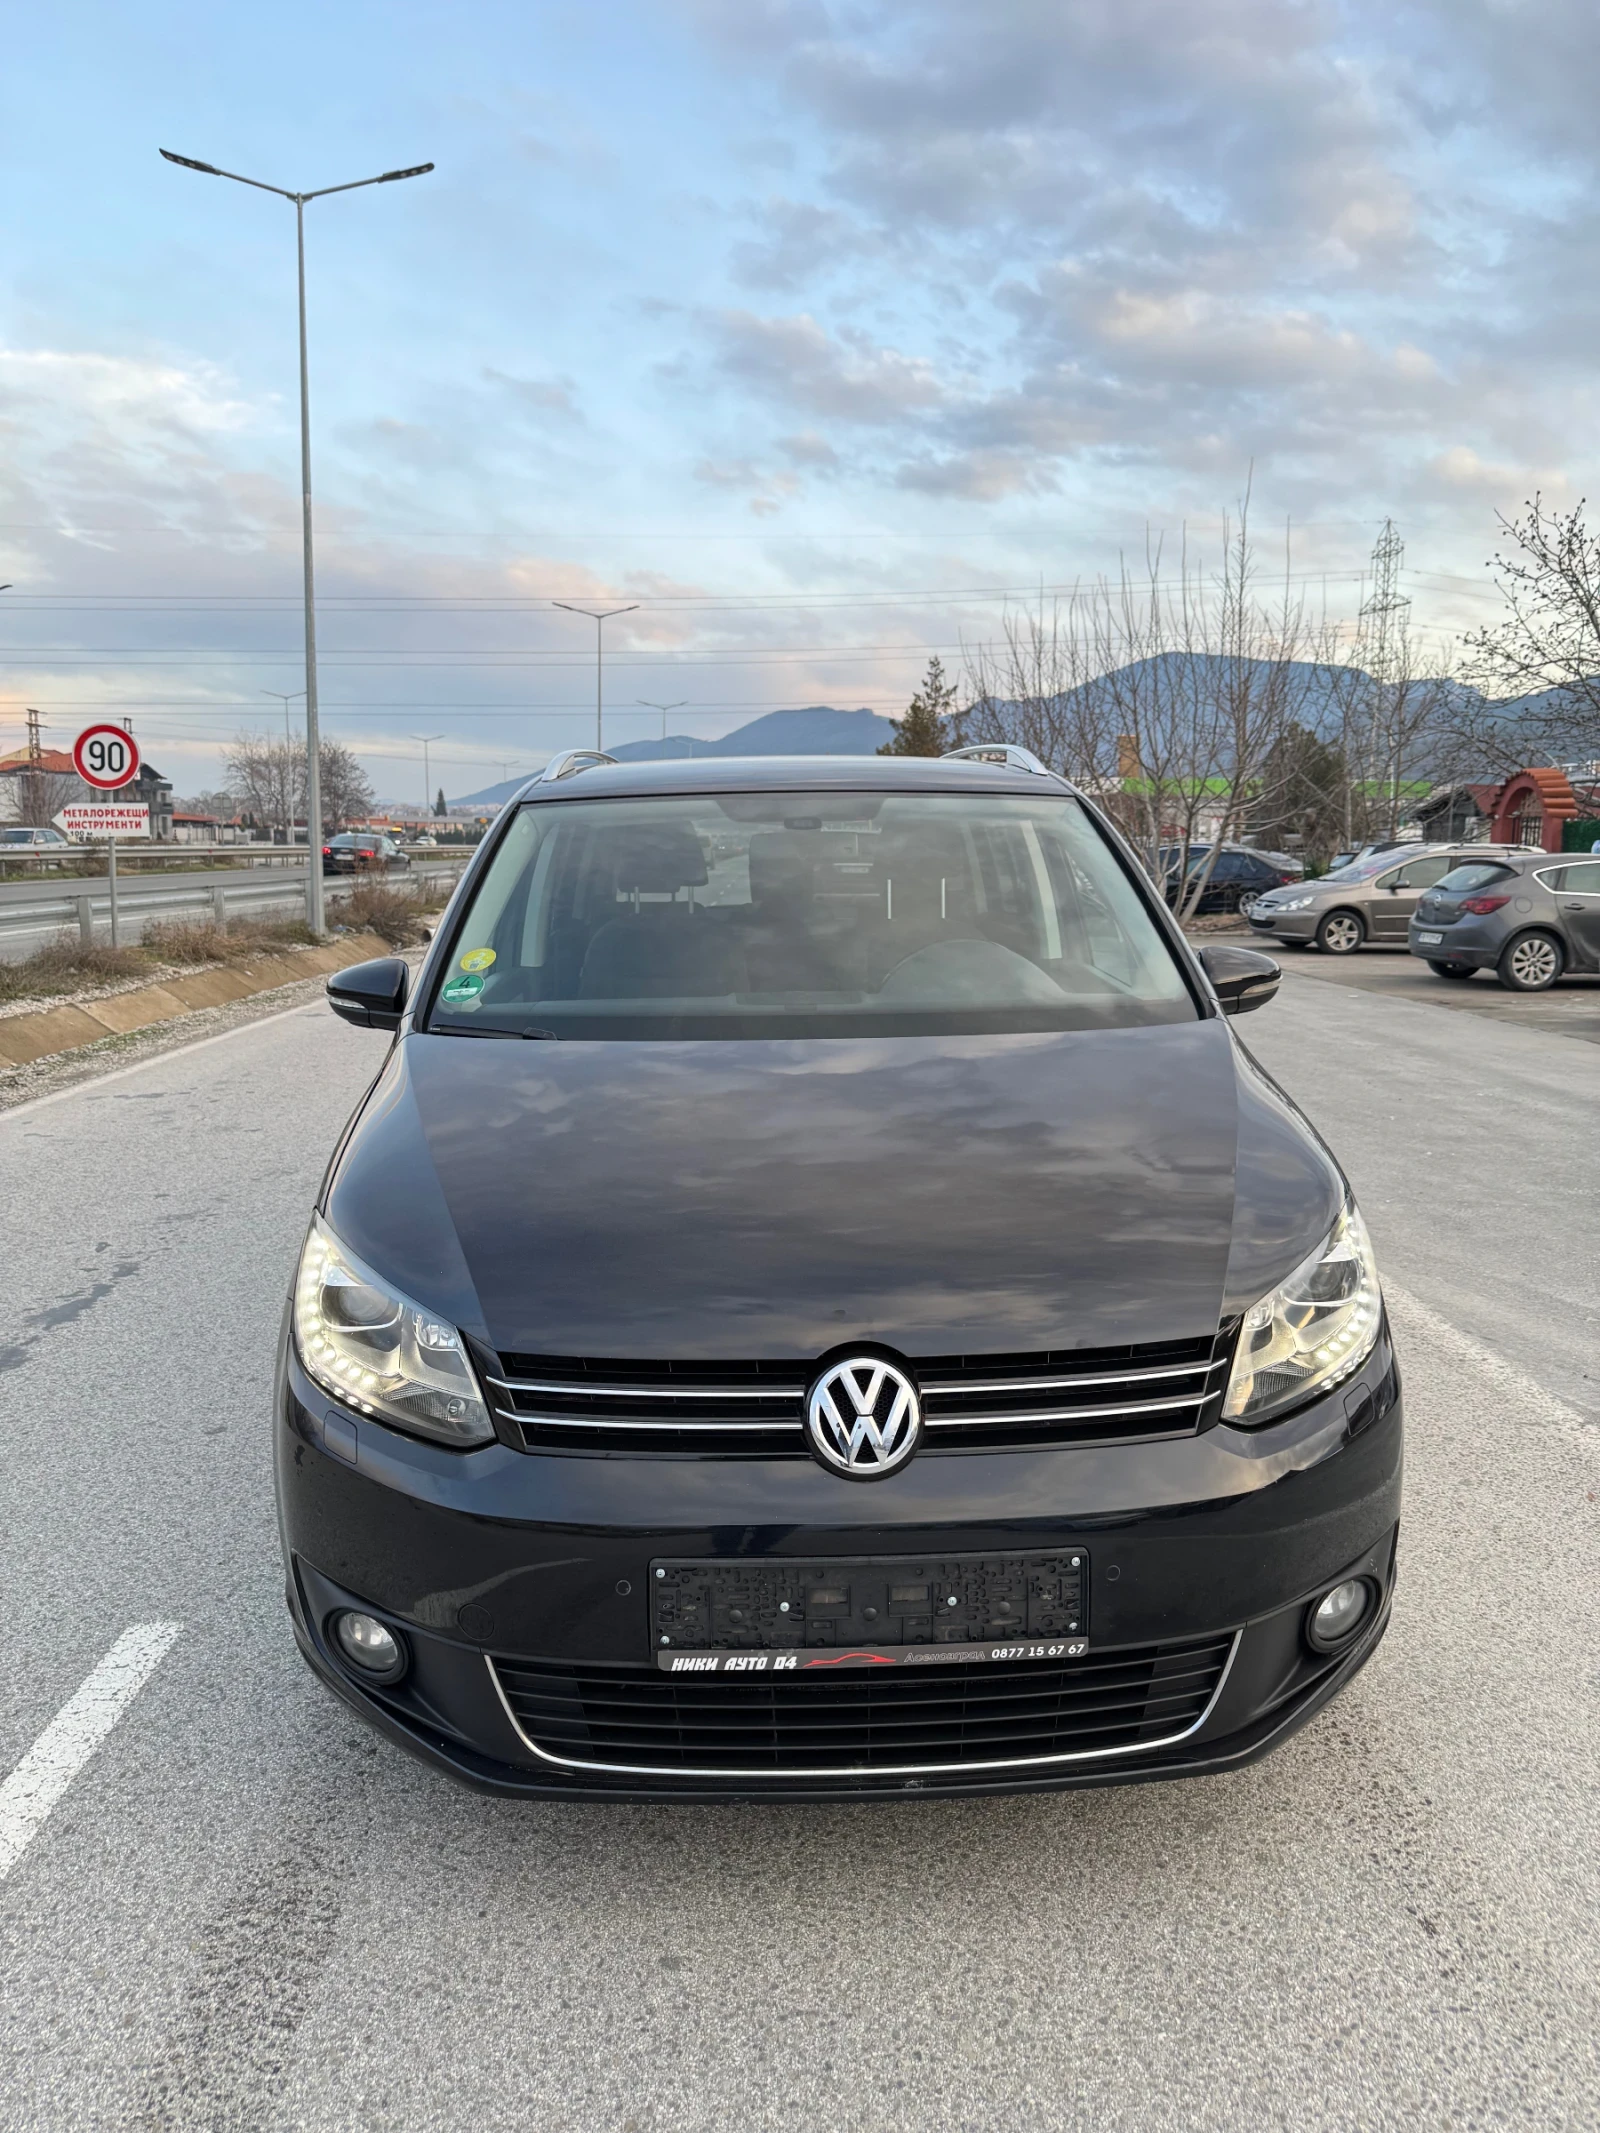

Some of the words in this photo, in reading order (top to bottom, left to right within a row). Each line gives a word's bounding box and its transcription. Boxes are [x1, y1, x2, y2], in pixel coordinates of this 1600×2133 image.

[88, 740, 125, 773] 90
[63, 808, 150, 819] МЕТАЛОРЕЖЕЩИ
[67, 820, 142, 830] ИНСТРУМЕНТИ
[458, 976, 471, 988] 4
[810, 1358, 920, 1475] VW
[991, 1647, 1024, 1659] 0877
[1028, 1646, 1044, 1657] 15
[1047, 1645, 1064, 1656] 67
[1068, 1643, 1085, 1655] 67
[671, 1657, 719, 1672] НИКИ
